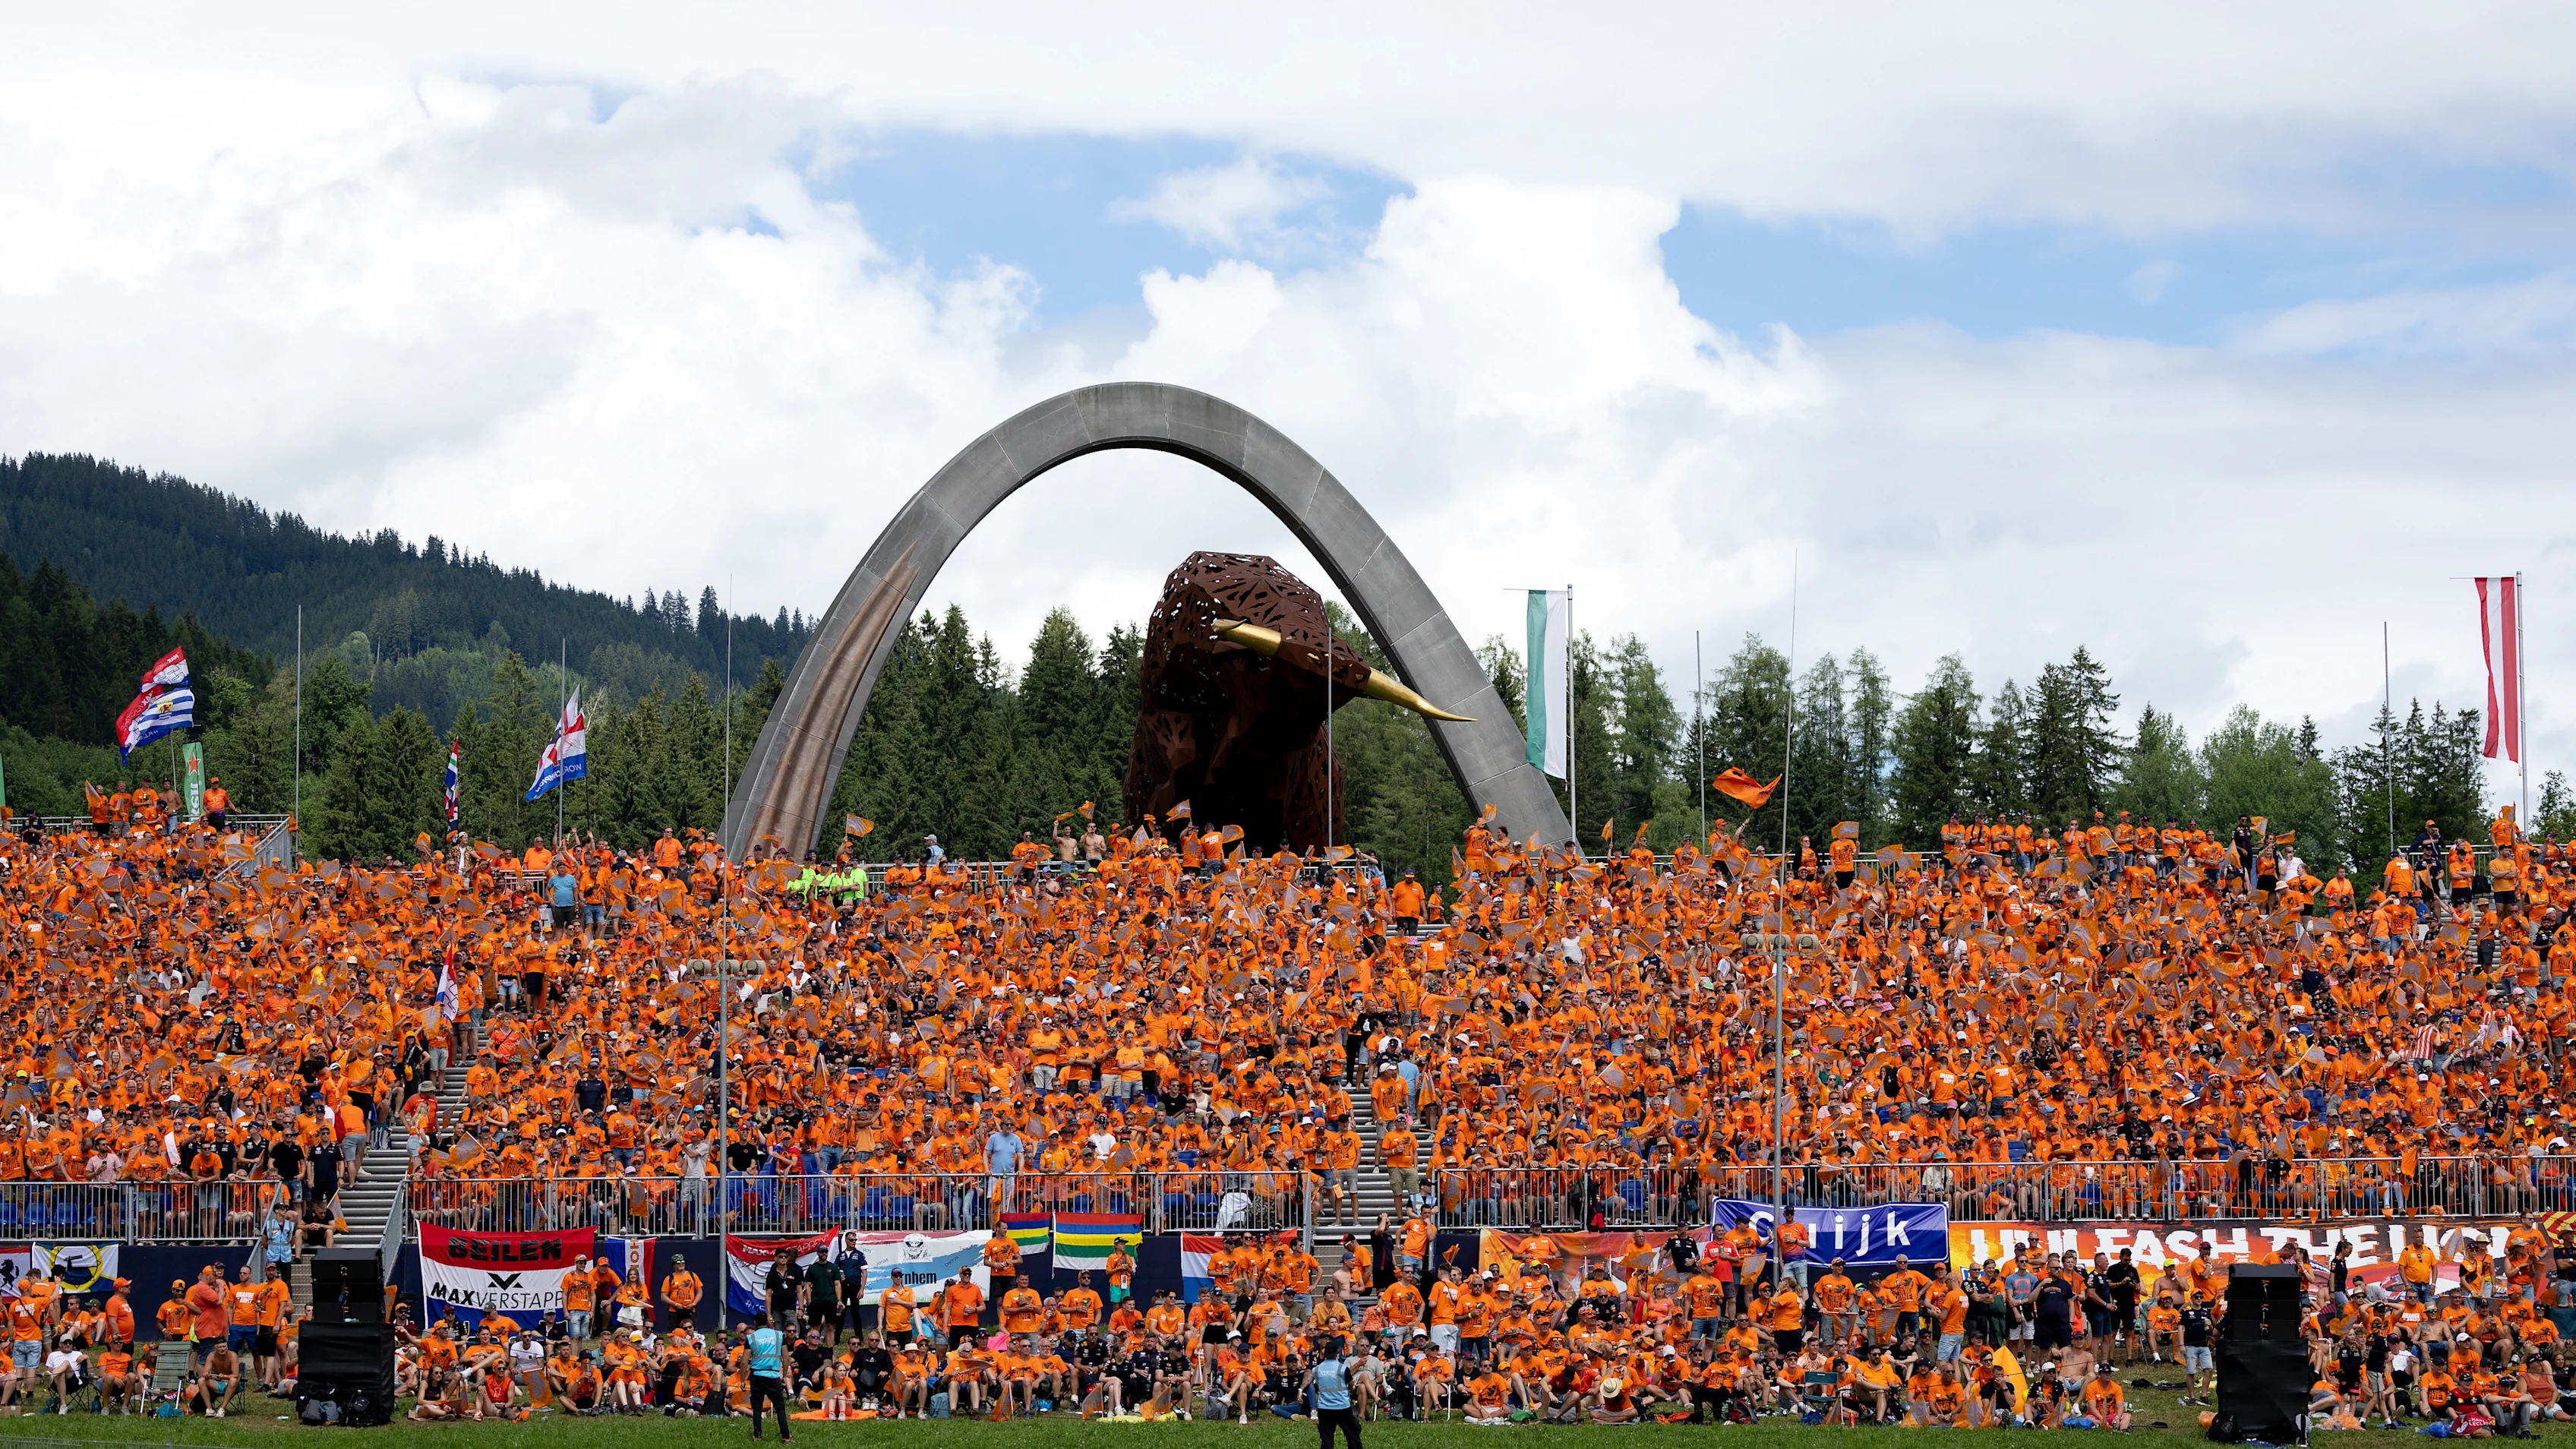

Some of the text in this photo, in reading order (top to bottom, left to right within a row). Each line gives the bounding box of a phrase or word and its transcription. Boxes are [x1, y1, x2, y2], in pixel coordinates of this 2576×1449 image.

[448, 1236, 562, 1262] BEILEN
[944, 1255, 959, 1267] Dennis
[1970, 1227, 2251, 1271] UNLEASH
[2259, 1225, 2379, 1270] THE
[431, 1281, 563, 1309] MAXVERSTAPP
